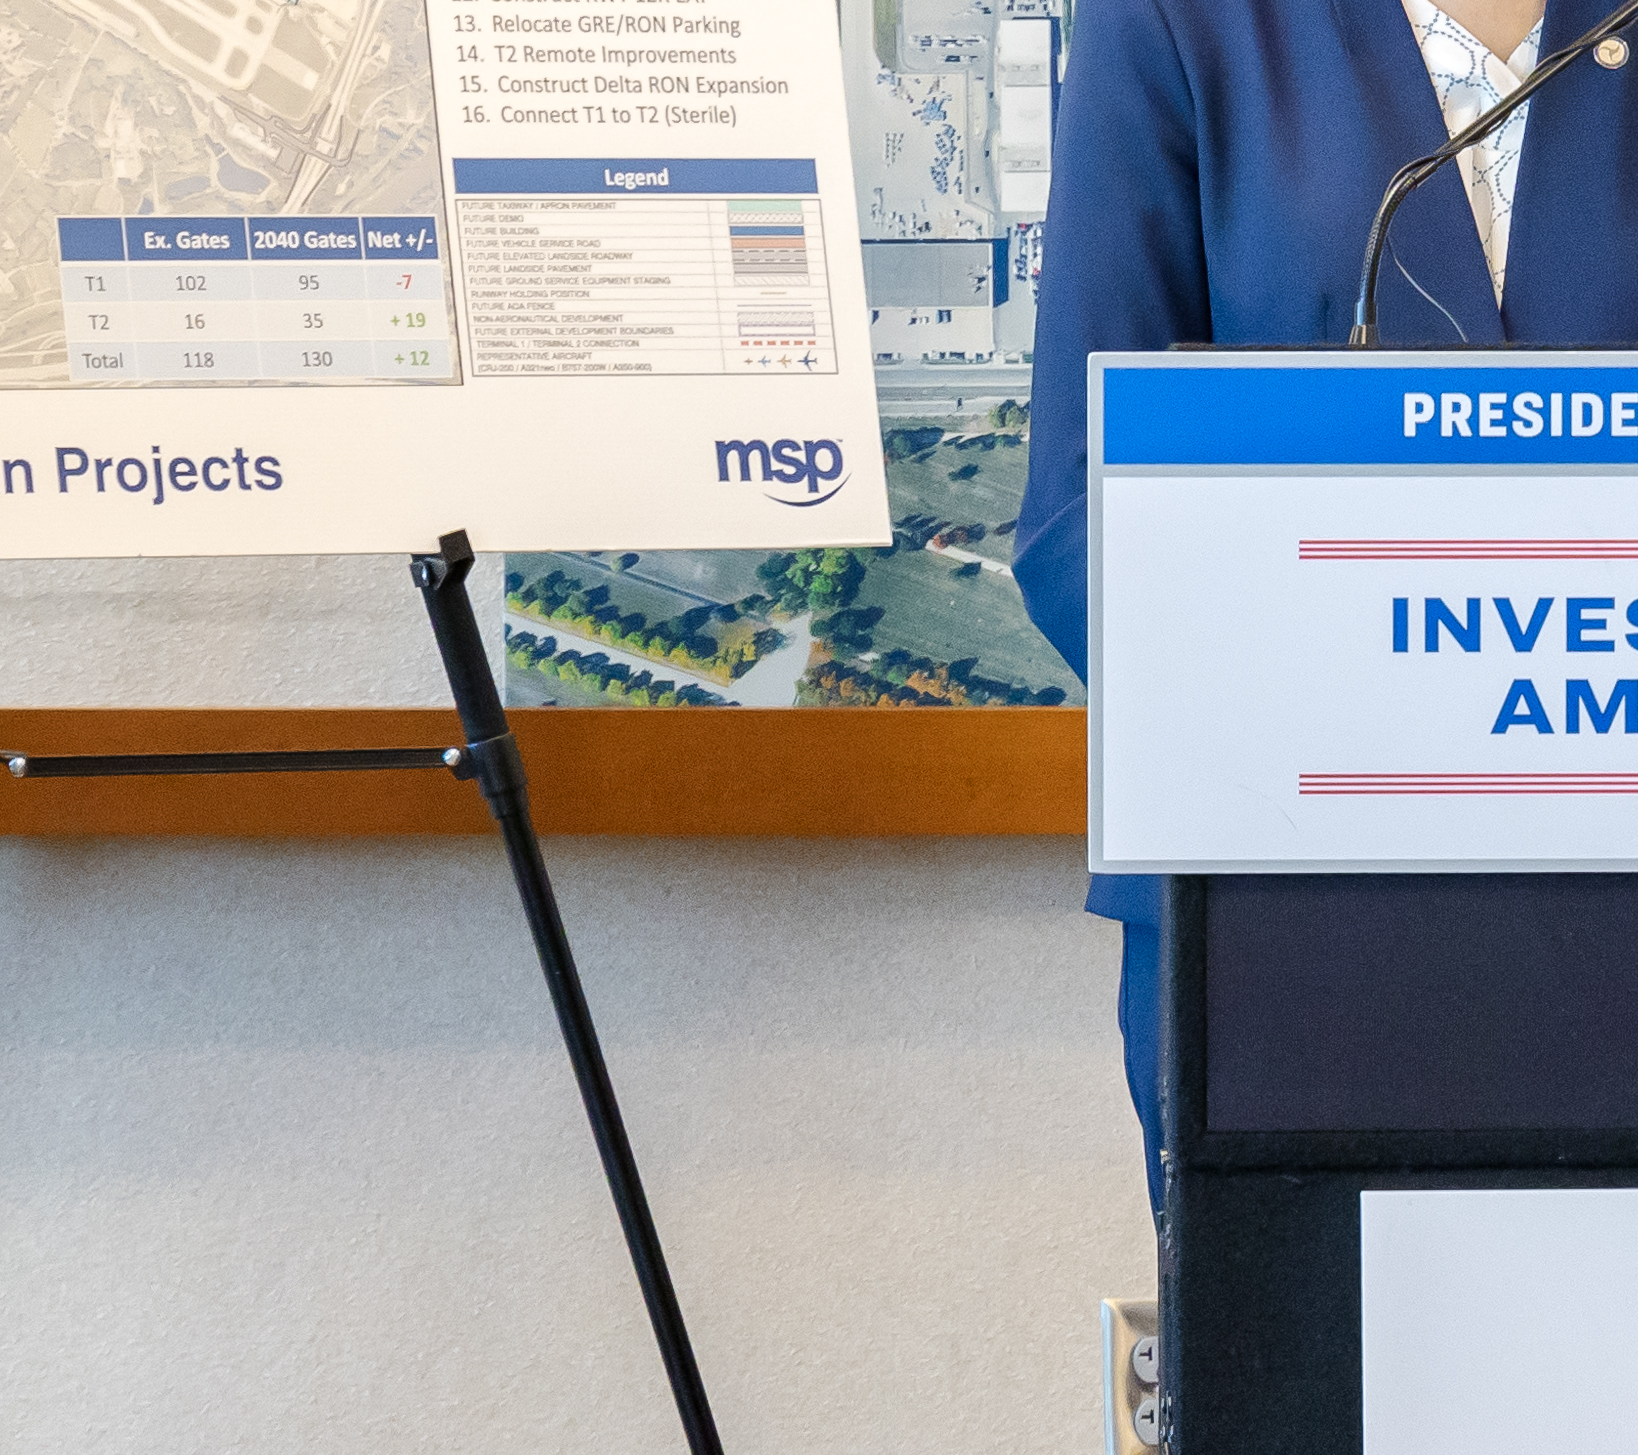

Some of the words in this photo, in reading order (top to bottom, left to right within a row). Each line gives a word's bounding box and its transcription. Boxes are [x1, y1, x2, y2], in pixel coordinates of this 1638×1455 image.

[453, 14, 482, 33] 13.
[492, 14, 572, 33] Relocate
[577, 14, 666, 37] GRE/RON
[672, 15, 742, 39] Parking
[456, 44, 485, 63] 14.
[493, 44, 518, 63] T2
[523, 45, 596, 64] Remote
[601, 45, 737, 68] Improvements
[459, 75, 488, 93] 15.
[497, 74, 589, 94] Construct
[593, 75, 643, 94] Delta
[648, 75, 690, 94] RON
[695, 76, 789, 98] Expansion
[462, 105, 491, 124] 16.
[500, 105, 579, 124] Connect
[582, 105, 606, 124] T1
[611, 107, 632, 124] to
[635, 105, 660, 124] T2
[665, 104, 737, 128] (Sterile)
[604, 167, 669, 190] Legend
[143, 231, 172, 249] Ex.
[175, 230, 231, 250] Gates
[253, 230, 300, 249] 2040
[303, 231, 357, 249] Gates
[367, 231, 402, 249] Net
[405, 228, 434, 252] +/-
[84, 276, 106, 292] T1
[175, 275, 207, 291] 102
[298, 274, 320, 291] 95
[396, 274, 412, 290] -7
[87, 314, 110, 331] T2
[184, 313, 206, 330] 16
[302, 312, 324, 329] 35
[390, 315, 401, 327] +
[405, 312, 426, 328] 19
[81, 352, 124, 369] Total
[183, 351, 215, 369] 118
[302, 351, 333, 368] 130
[394, 353, 405, 365] +
[410, 350, 430, 366] 12
[715, 439, 843, 493] msp
[55, 445, 283, 506] Projects
